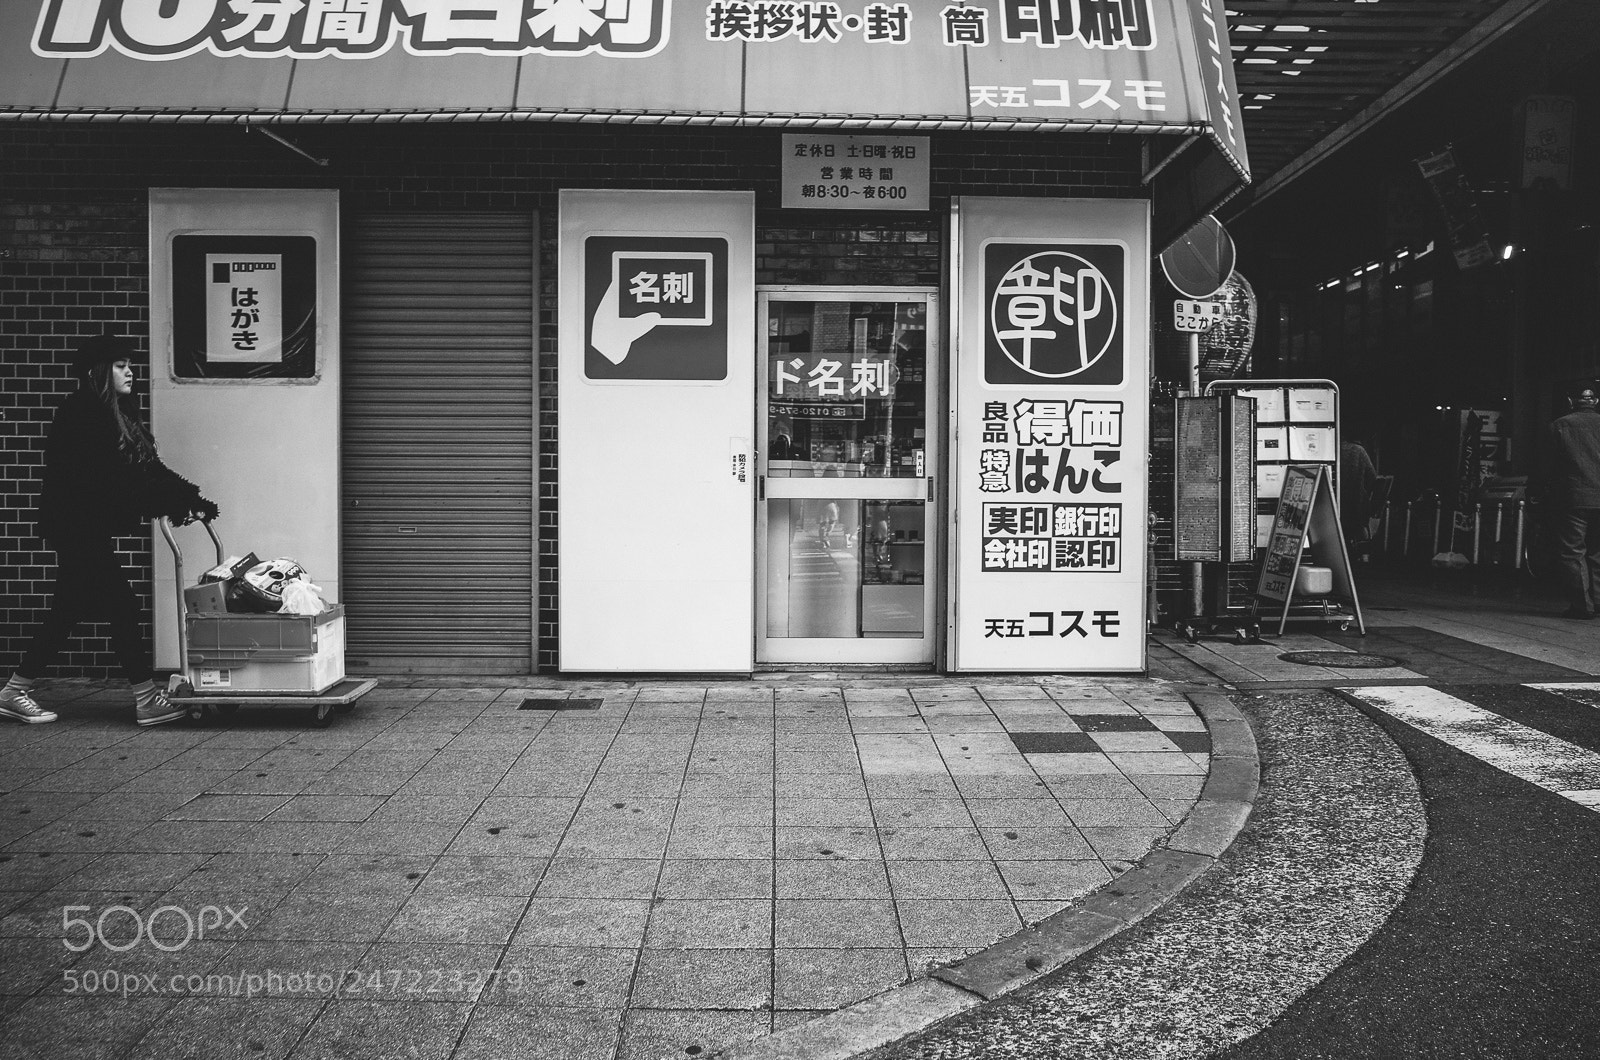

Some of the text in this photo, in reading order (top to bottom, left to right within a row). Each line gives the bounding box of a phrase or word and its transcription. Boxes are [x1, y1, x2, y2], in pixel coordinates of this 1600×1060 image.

[969, 78, 1167, 111] 天五コスモ
[794, 143, 835, 157] 定休日
[820, 166, 893, 181] 営業時間
[628, 271, 694, 304] 名刺
[231, 287, 260, 350] はがき
[776, 358, 890, 397] ド名刺
[982, 400, 1009, 443] 良品
[1013, 398, 1124, 447] 得価
[979, 449, 1011, 493] 特急
[1015, 447, 1122, 494] はんこ
[988, 506, 1048, 536] 実印
[1054, 506, 1120, 537] 銀行印
[984, 539, 1049, 569] 会社印
[1055, 539, 1116, 569] 認印
[984, 610, 1120, 638] 天五コスモ
